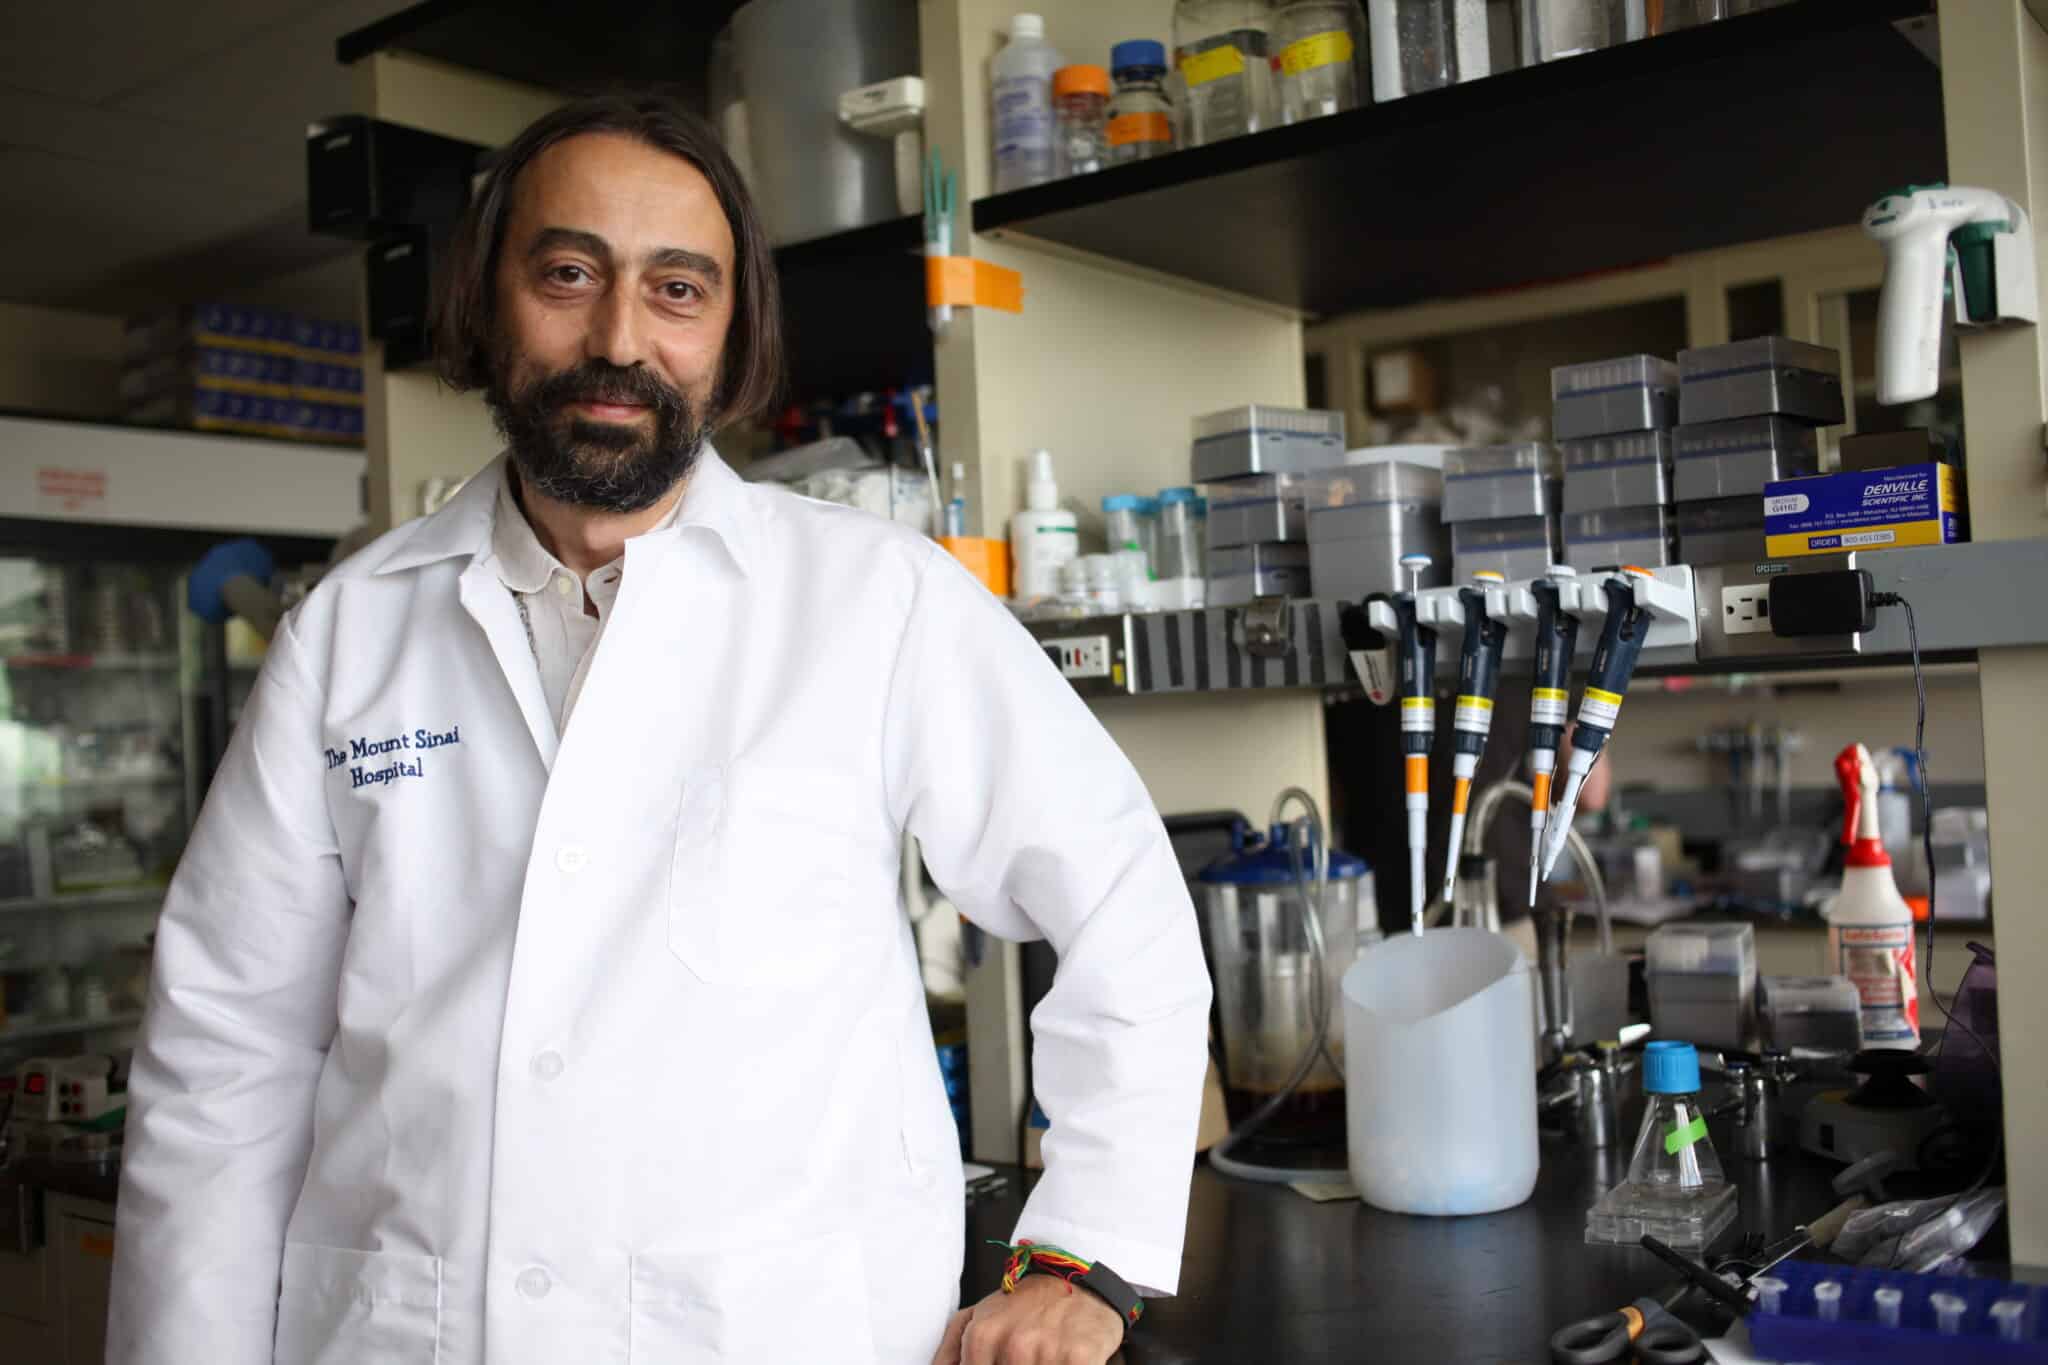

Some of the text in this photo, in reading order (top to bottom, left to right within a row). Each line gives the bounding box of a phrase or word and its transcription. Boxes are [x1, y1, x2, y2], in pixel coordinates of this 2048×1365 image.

[1864, 479, 1928, 495] DENVILLE
[325, 726, 460, 769] The Mount Sinai
[350, 757, 424, 789] Hospital
